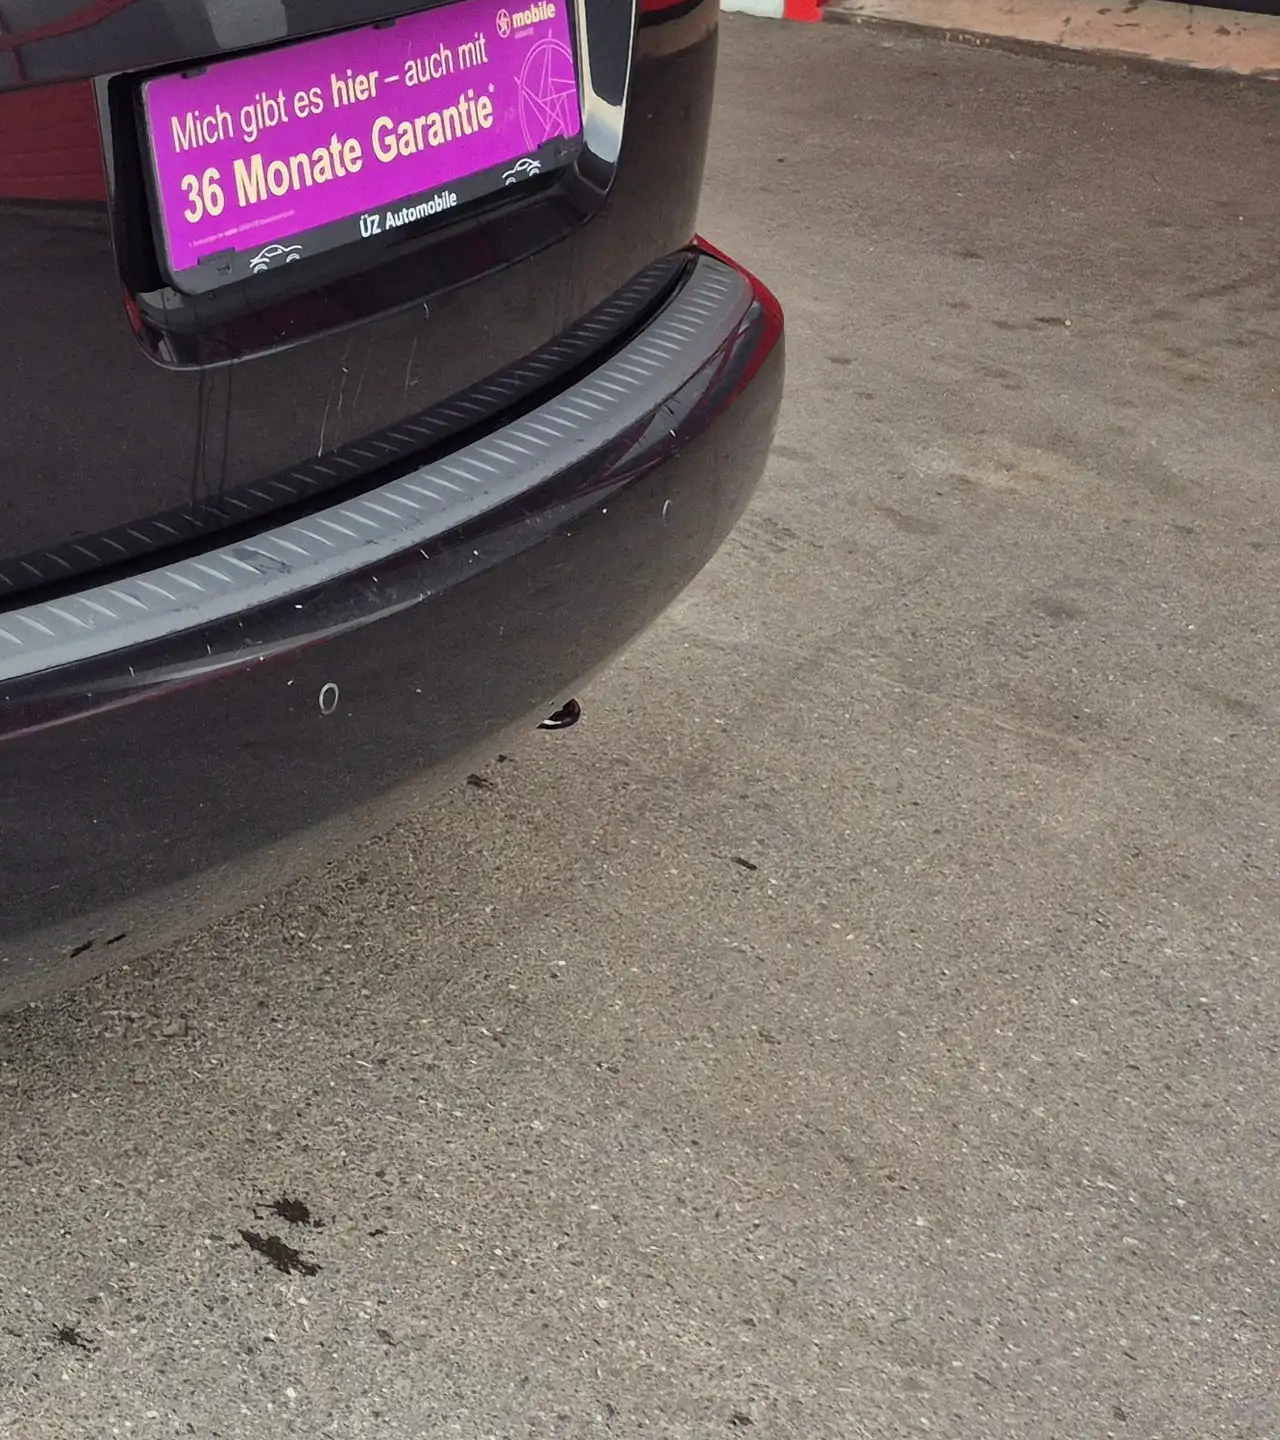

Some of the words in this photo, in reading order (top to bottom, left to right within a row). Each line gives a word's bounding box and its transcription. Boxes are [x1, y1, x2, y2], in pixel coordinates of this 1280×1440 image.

[512, 0, 556, 29] mobile
[170, 105, 234, 152] Mich
[241, 89, 288, 142] gibt
[294, 87, 323, 118] es
[330, 69, 379, 108] hier
[405, 43, 454, 87] auch
[458, 32, 489, 70] mit
[181, 168, 225, 223] 36
[234, 133, 362, 207] Monate
[359, 213, 382, 238] ÜZ
[385, 190, 458, 230] Automobile
